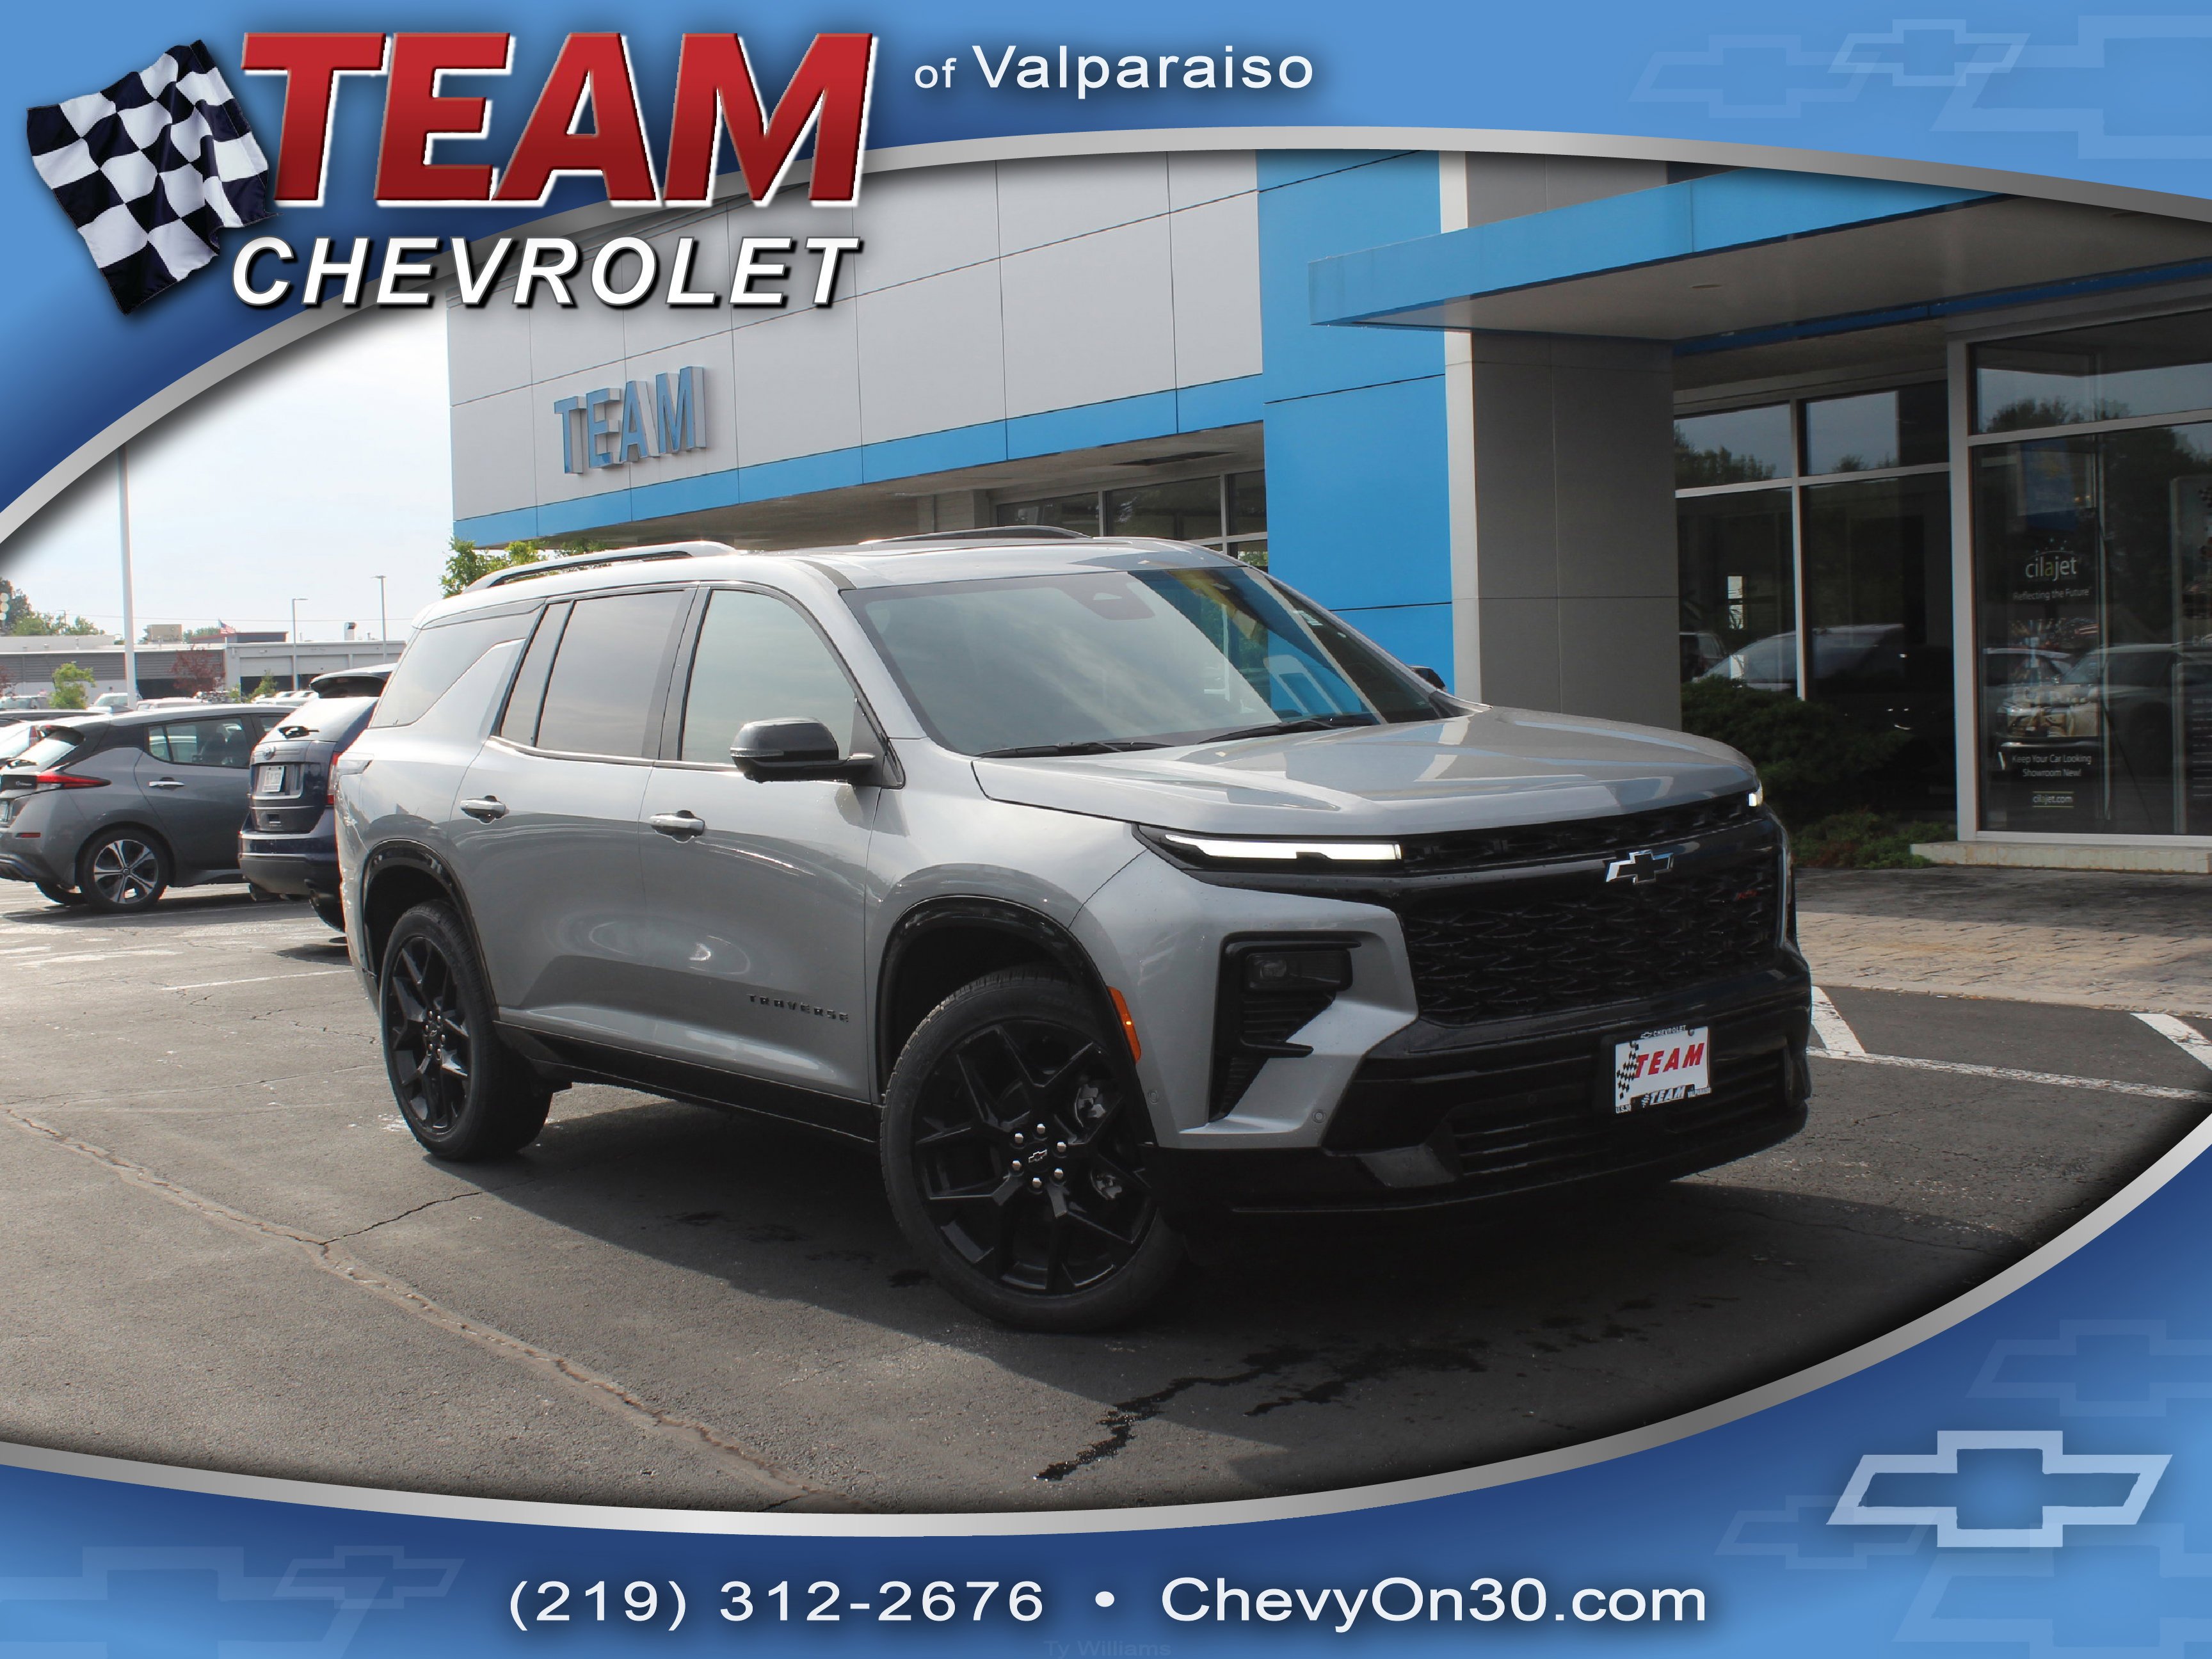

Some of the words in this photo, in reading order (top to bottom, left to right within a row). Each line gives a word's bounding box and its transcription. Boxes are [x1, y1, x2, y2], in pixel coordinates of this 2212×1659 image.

[554, 365, 707, 474] TEAM
[2025, 556, 2078, 582] cilajet
[2012, 755, 2032, 765] Keep
[2032, 754, 2048, 763] Your
[2049, 754, 2062, 763] Car
[2063, 754, 2092, 765] Looking
[2022, 768, 2062, 777] Showroom
[746, 993, 849, 1023] TRAVERSE
[1653, 1025, 1687, 1037] CHEVROLET
[1634, 1043, 1705, 1078] TEAM
[1649, 1084, 1687, 1106] TEAM
